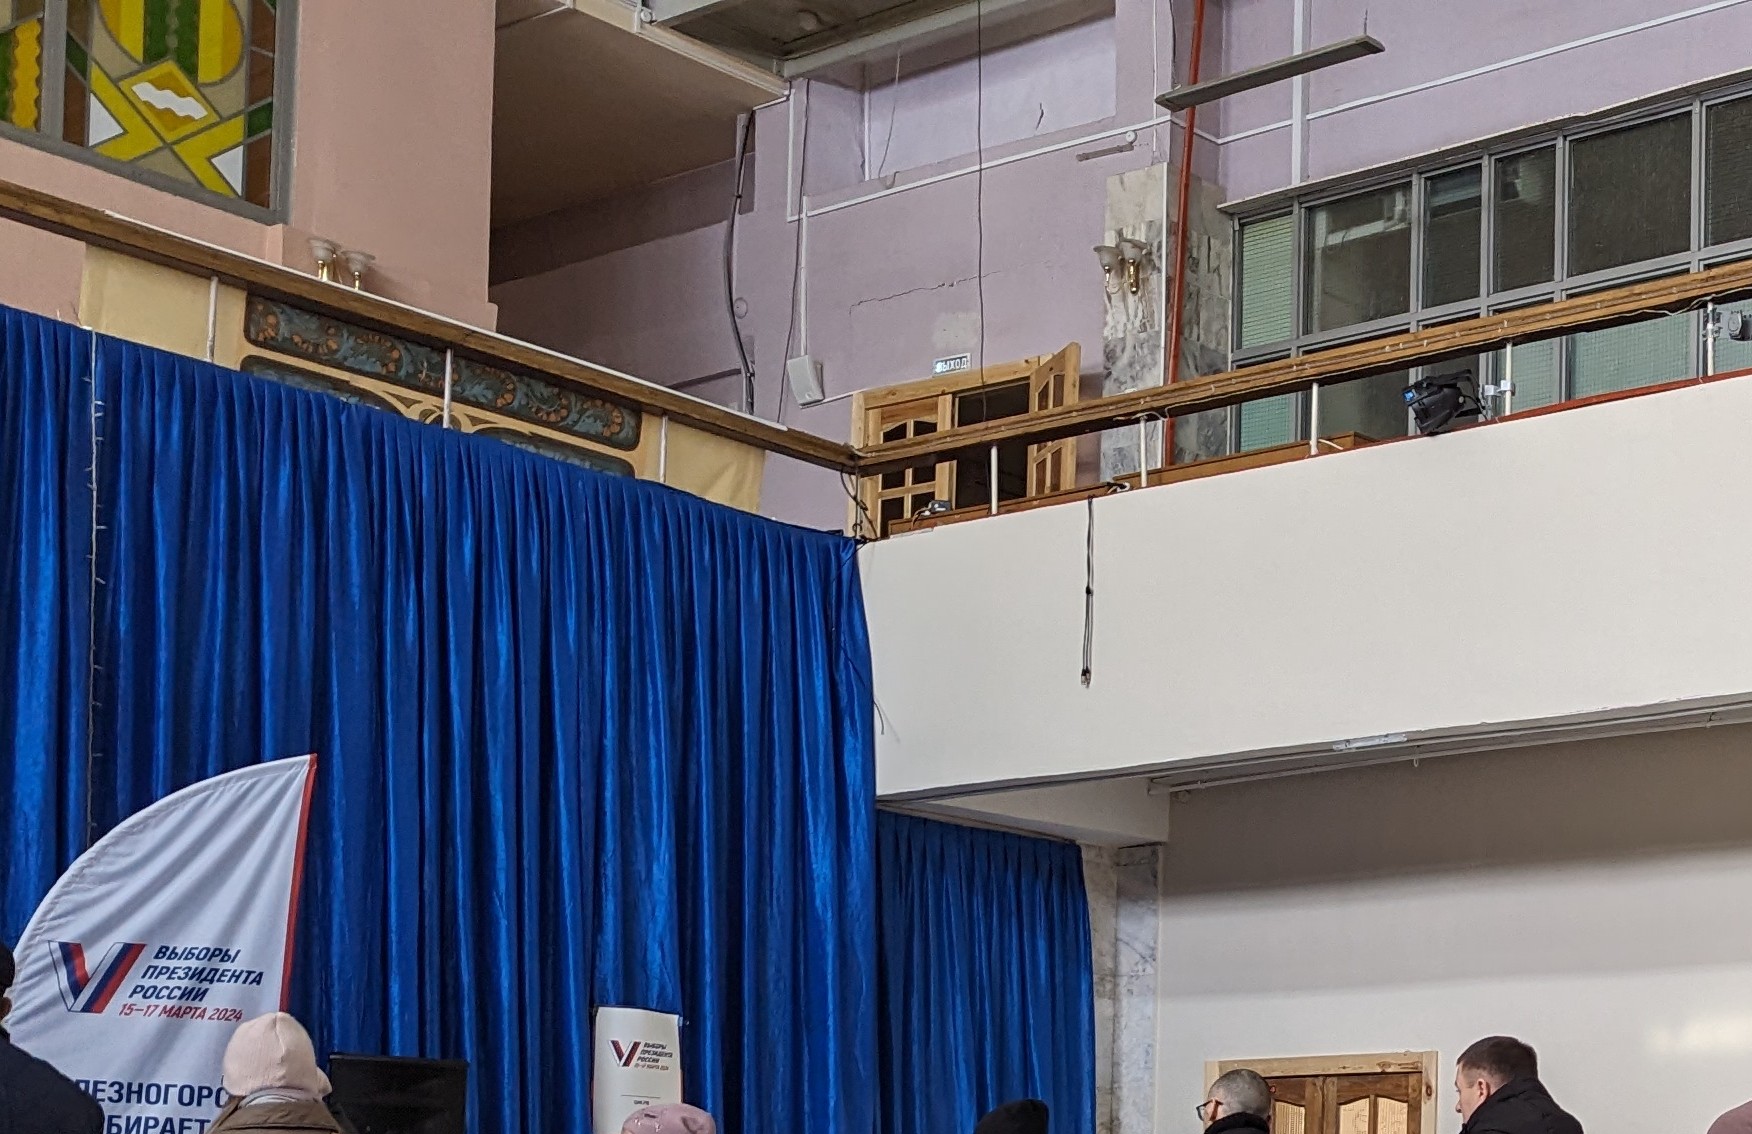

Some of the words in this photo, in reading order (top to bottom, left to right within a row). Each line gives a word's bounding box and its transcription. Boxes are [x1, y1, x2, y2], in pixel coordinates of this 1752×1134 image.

[935, 358, 967, 373] ВЫХОД
[153, 945, 241, 964] ВЫБОРЫ
[141, 965, 264, 986] ПРЕЗИДЕНТА
[128, 984, 209, 1003] РОССИИ
[159, 1004, 206, 1021] МАРТА
[208, 1008, 243, 1022] 2024
